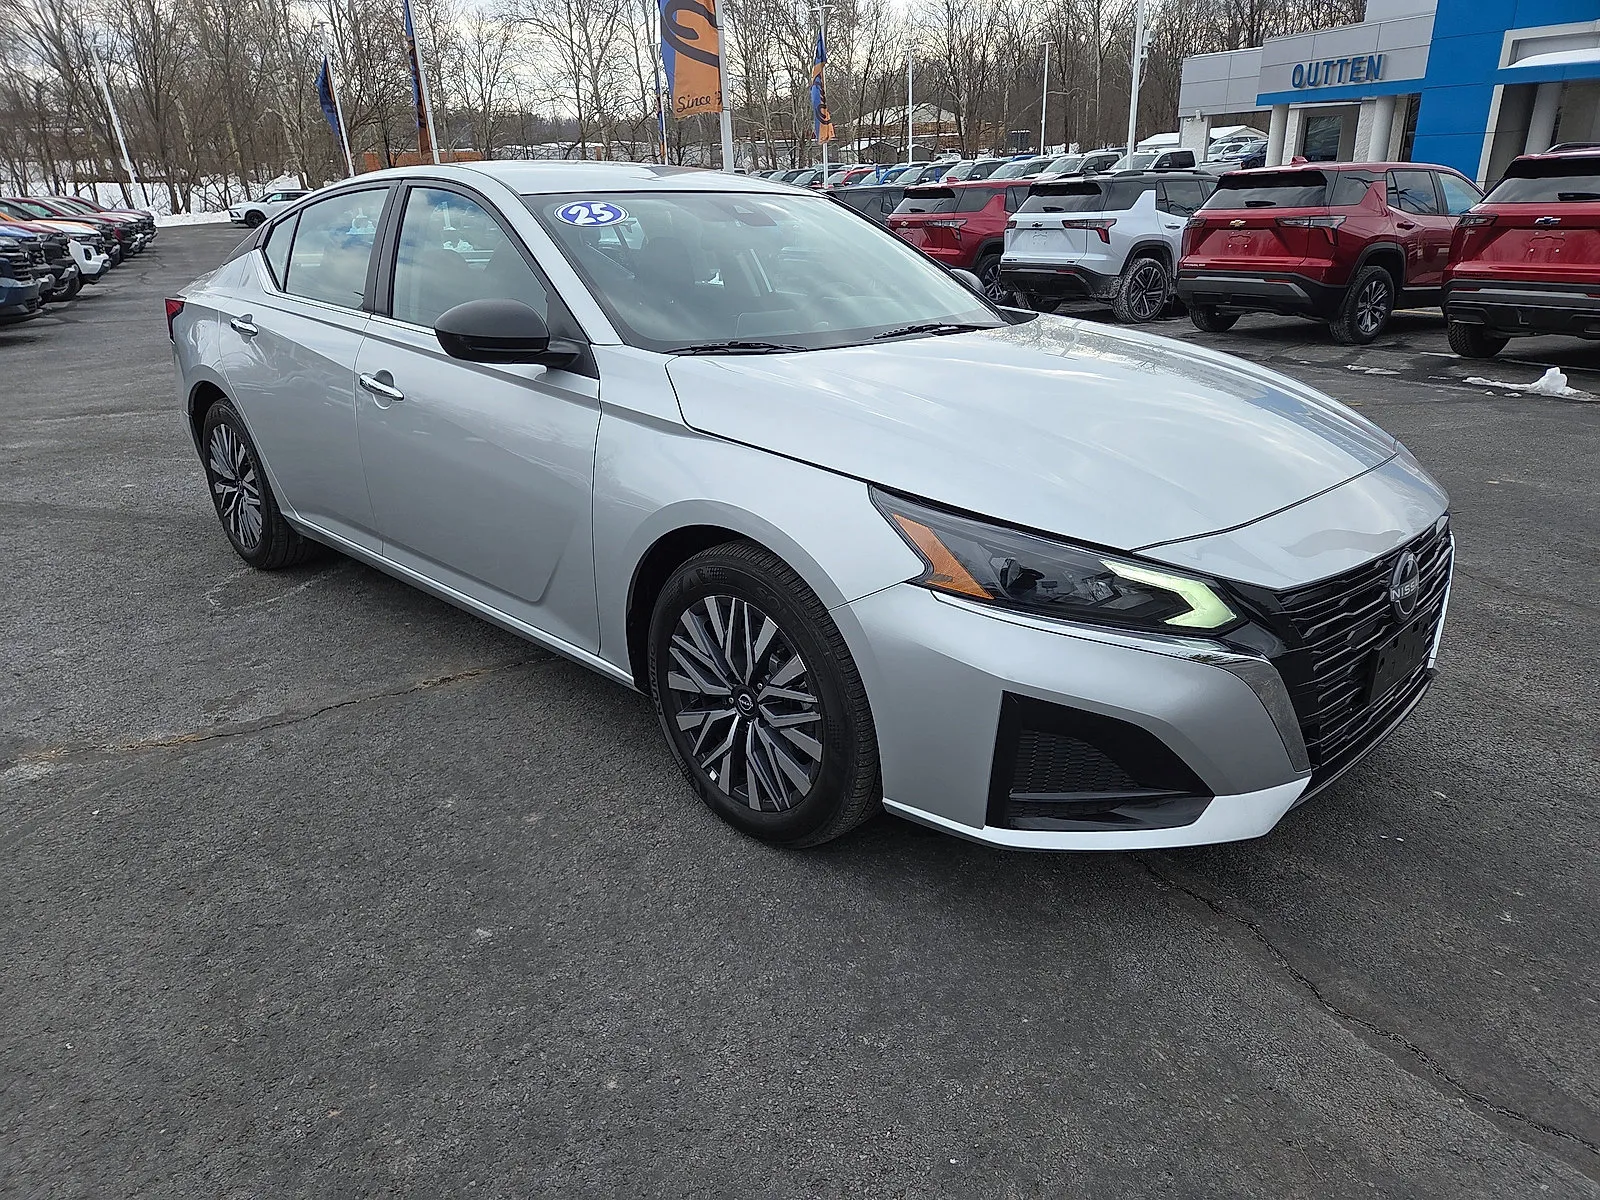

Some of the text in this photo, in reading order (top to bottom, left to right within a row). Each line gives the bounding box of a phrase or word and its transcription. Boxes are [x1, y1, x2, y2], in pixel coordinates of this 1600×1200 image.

[1291, 54, 1385, 88] OUTTEN
[676, 94, 711, 113] Since
[567, 203, 615, 225] 25
